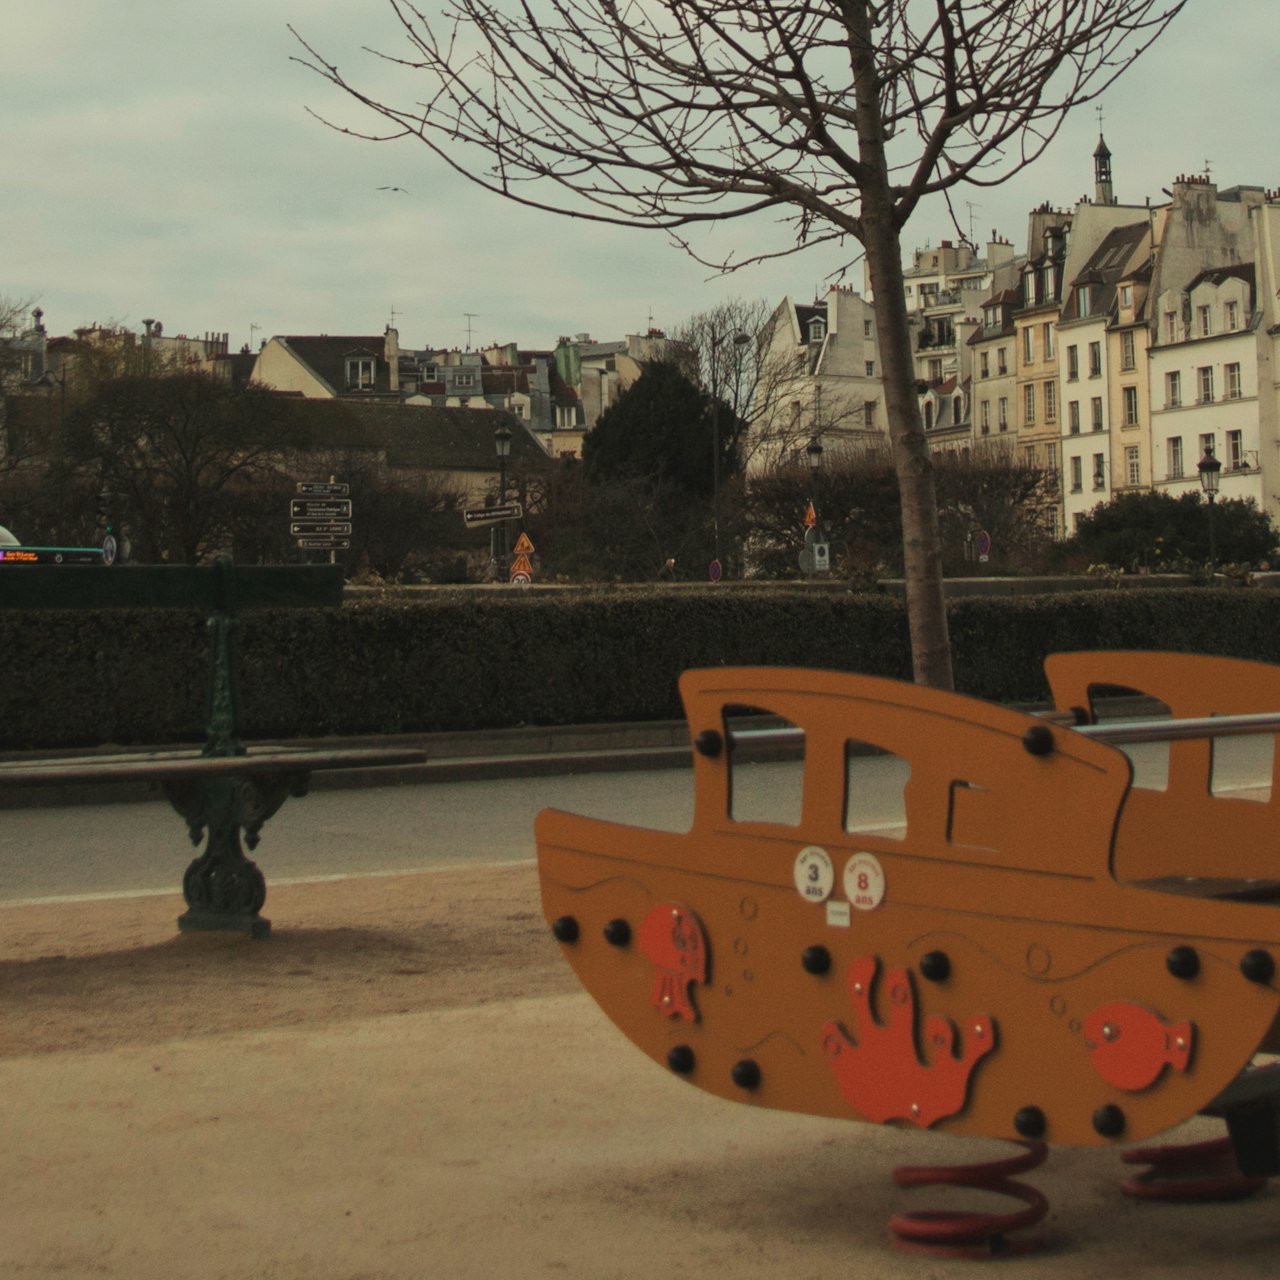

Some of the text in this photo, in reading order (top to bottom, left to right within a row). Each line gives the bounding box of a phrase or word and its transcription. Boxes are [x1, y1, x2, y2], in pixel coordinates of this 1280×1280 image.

[808, 864, 819, 882] 3
[857, 872, 869, 890] 8
[805, 886, 823, 897] ans
[855, 895, 873, 905] ans
